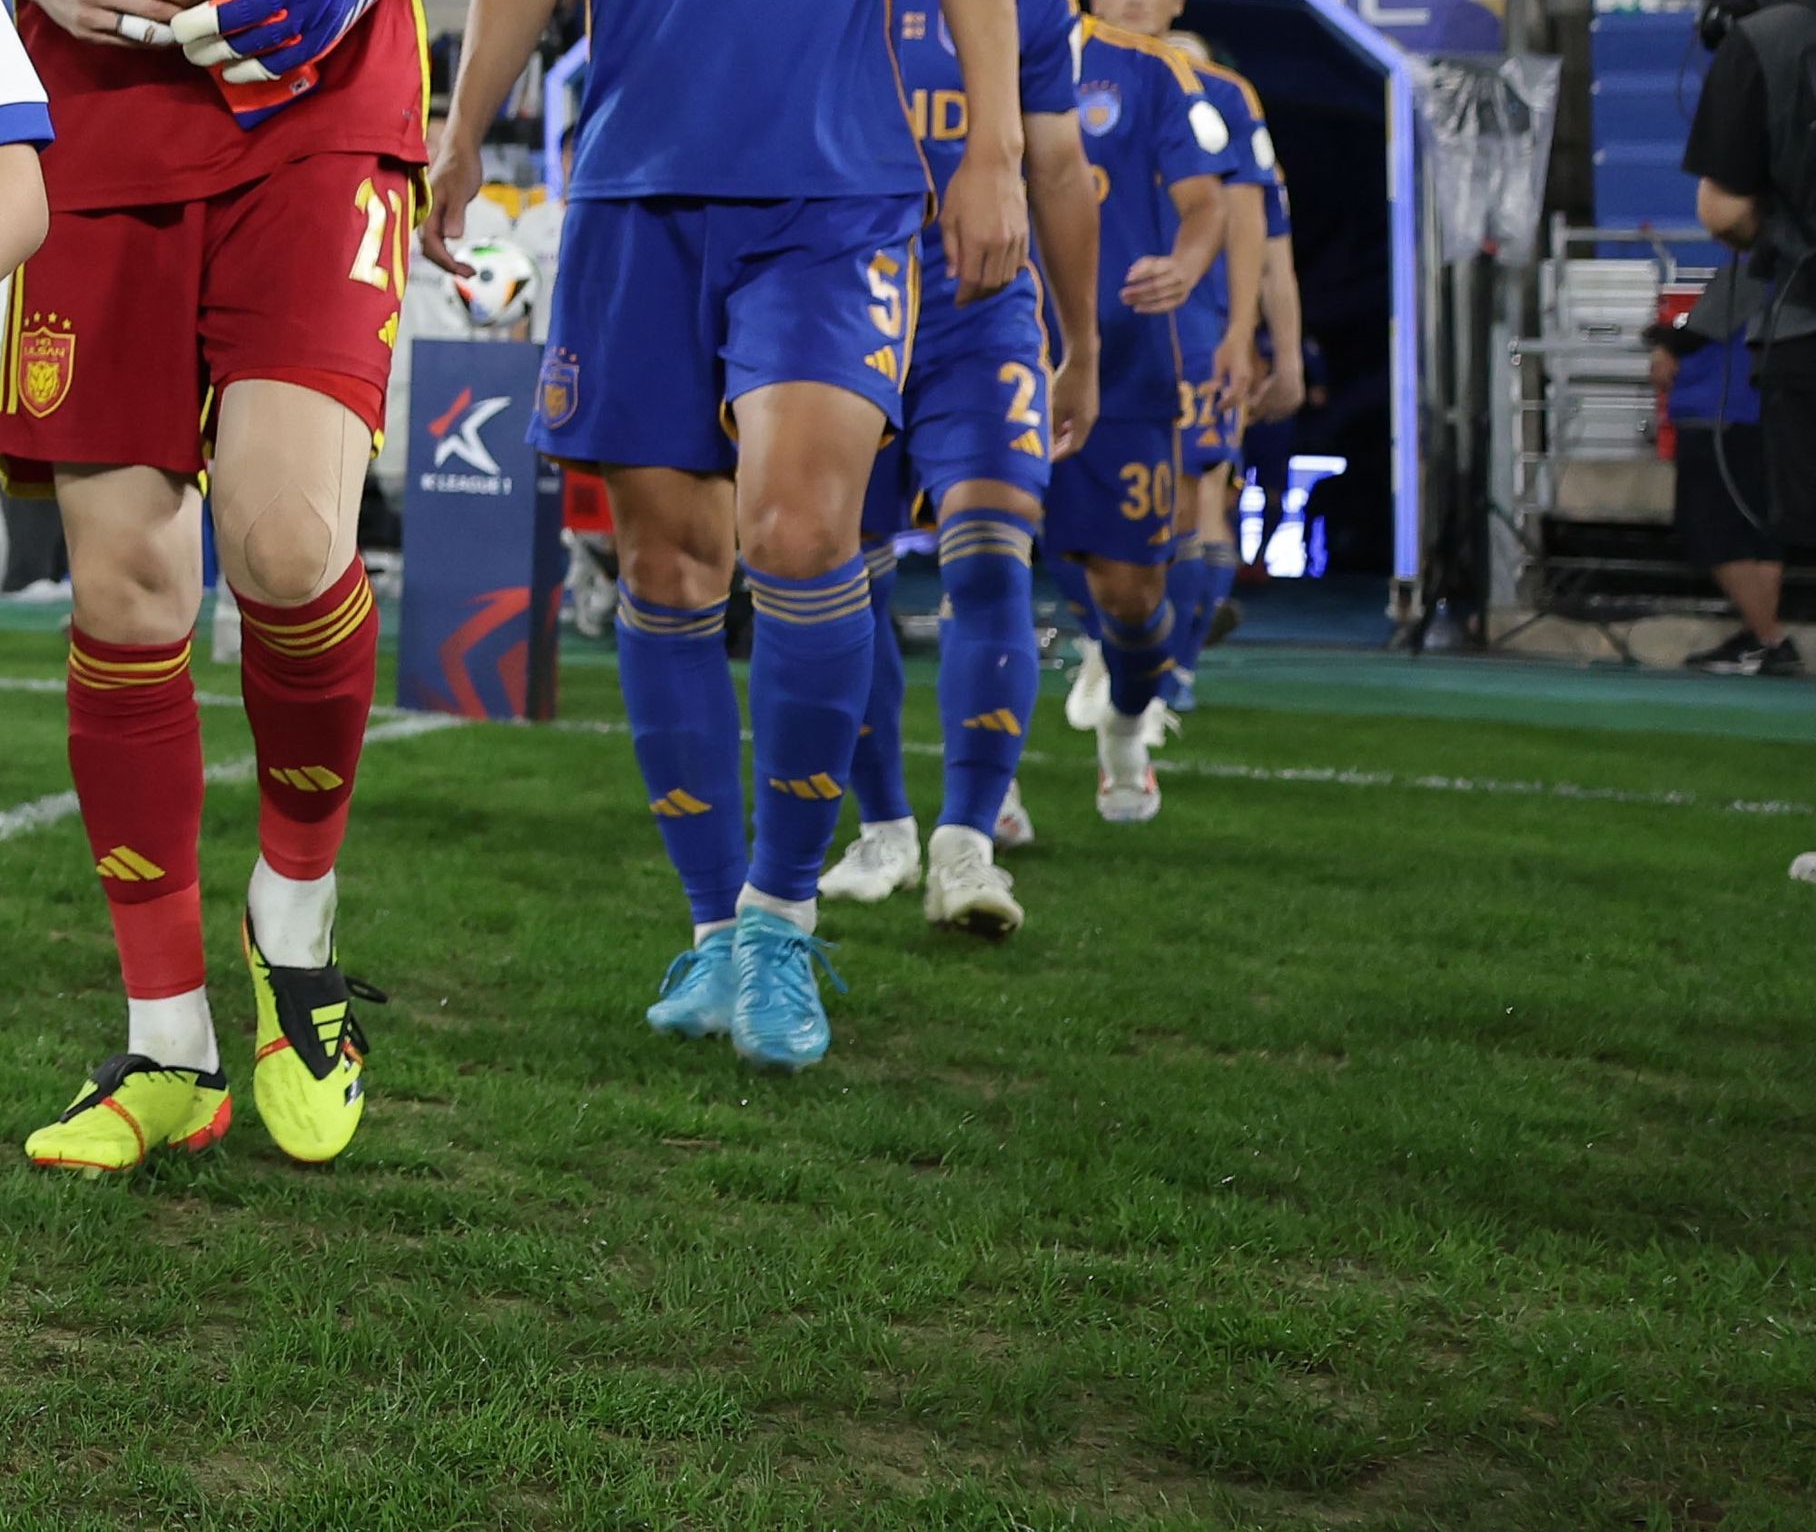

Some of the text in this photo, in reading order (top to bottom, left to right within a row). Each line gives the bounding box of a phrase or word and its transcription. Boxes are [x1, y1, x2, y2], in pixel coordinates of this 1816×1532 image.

[867, 250, 902, 339] 5
[998, 361, 1042, 427] 2
[437, 473, 501, 496] LEAGUE
[1119, 461, 1171, 521] 30
